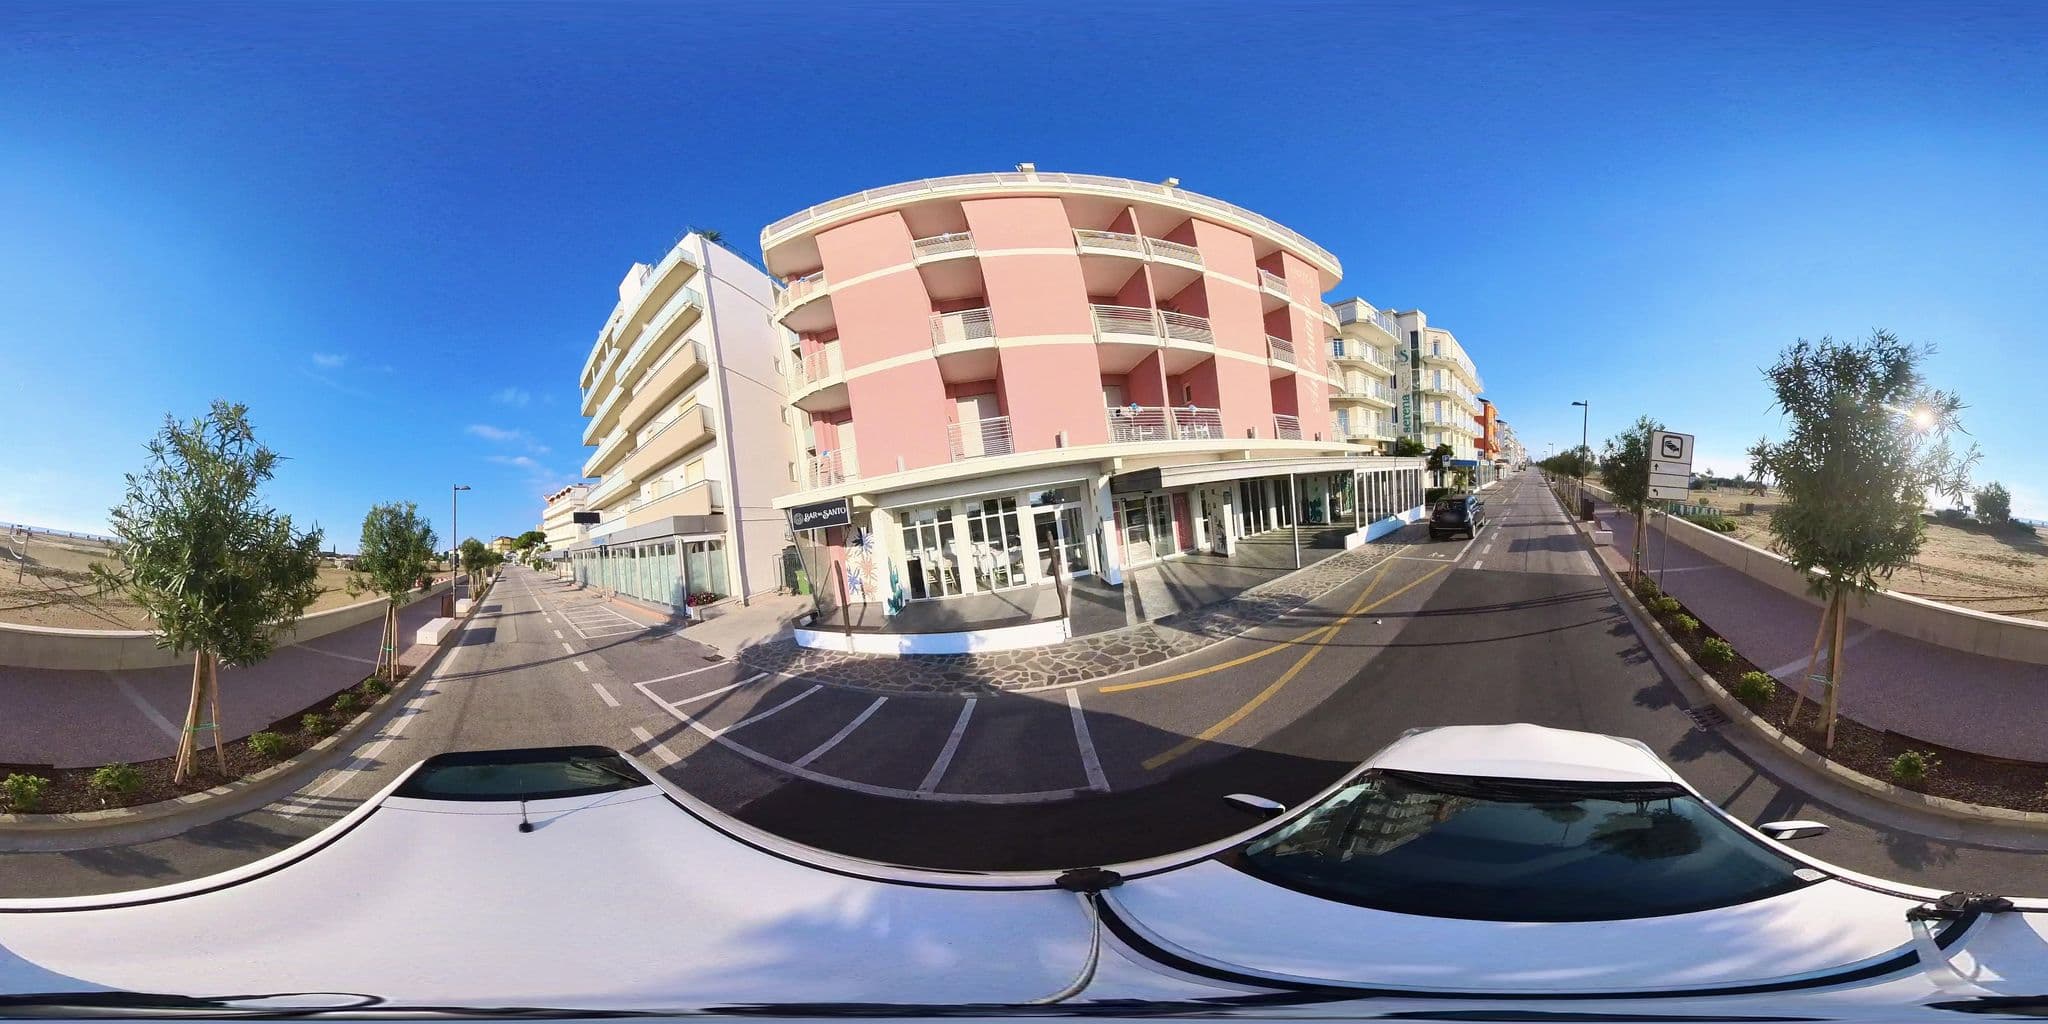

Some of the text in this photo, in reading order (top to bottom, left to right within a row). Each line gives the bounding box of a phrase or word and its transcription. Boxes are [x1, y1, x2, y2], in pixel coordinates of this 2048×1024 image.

[1402, 394, 1411, 433] serena
[804, 511, 818, 522] BAR
[822, 507, 846, 520] SANTO
